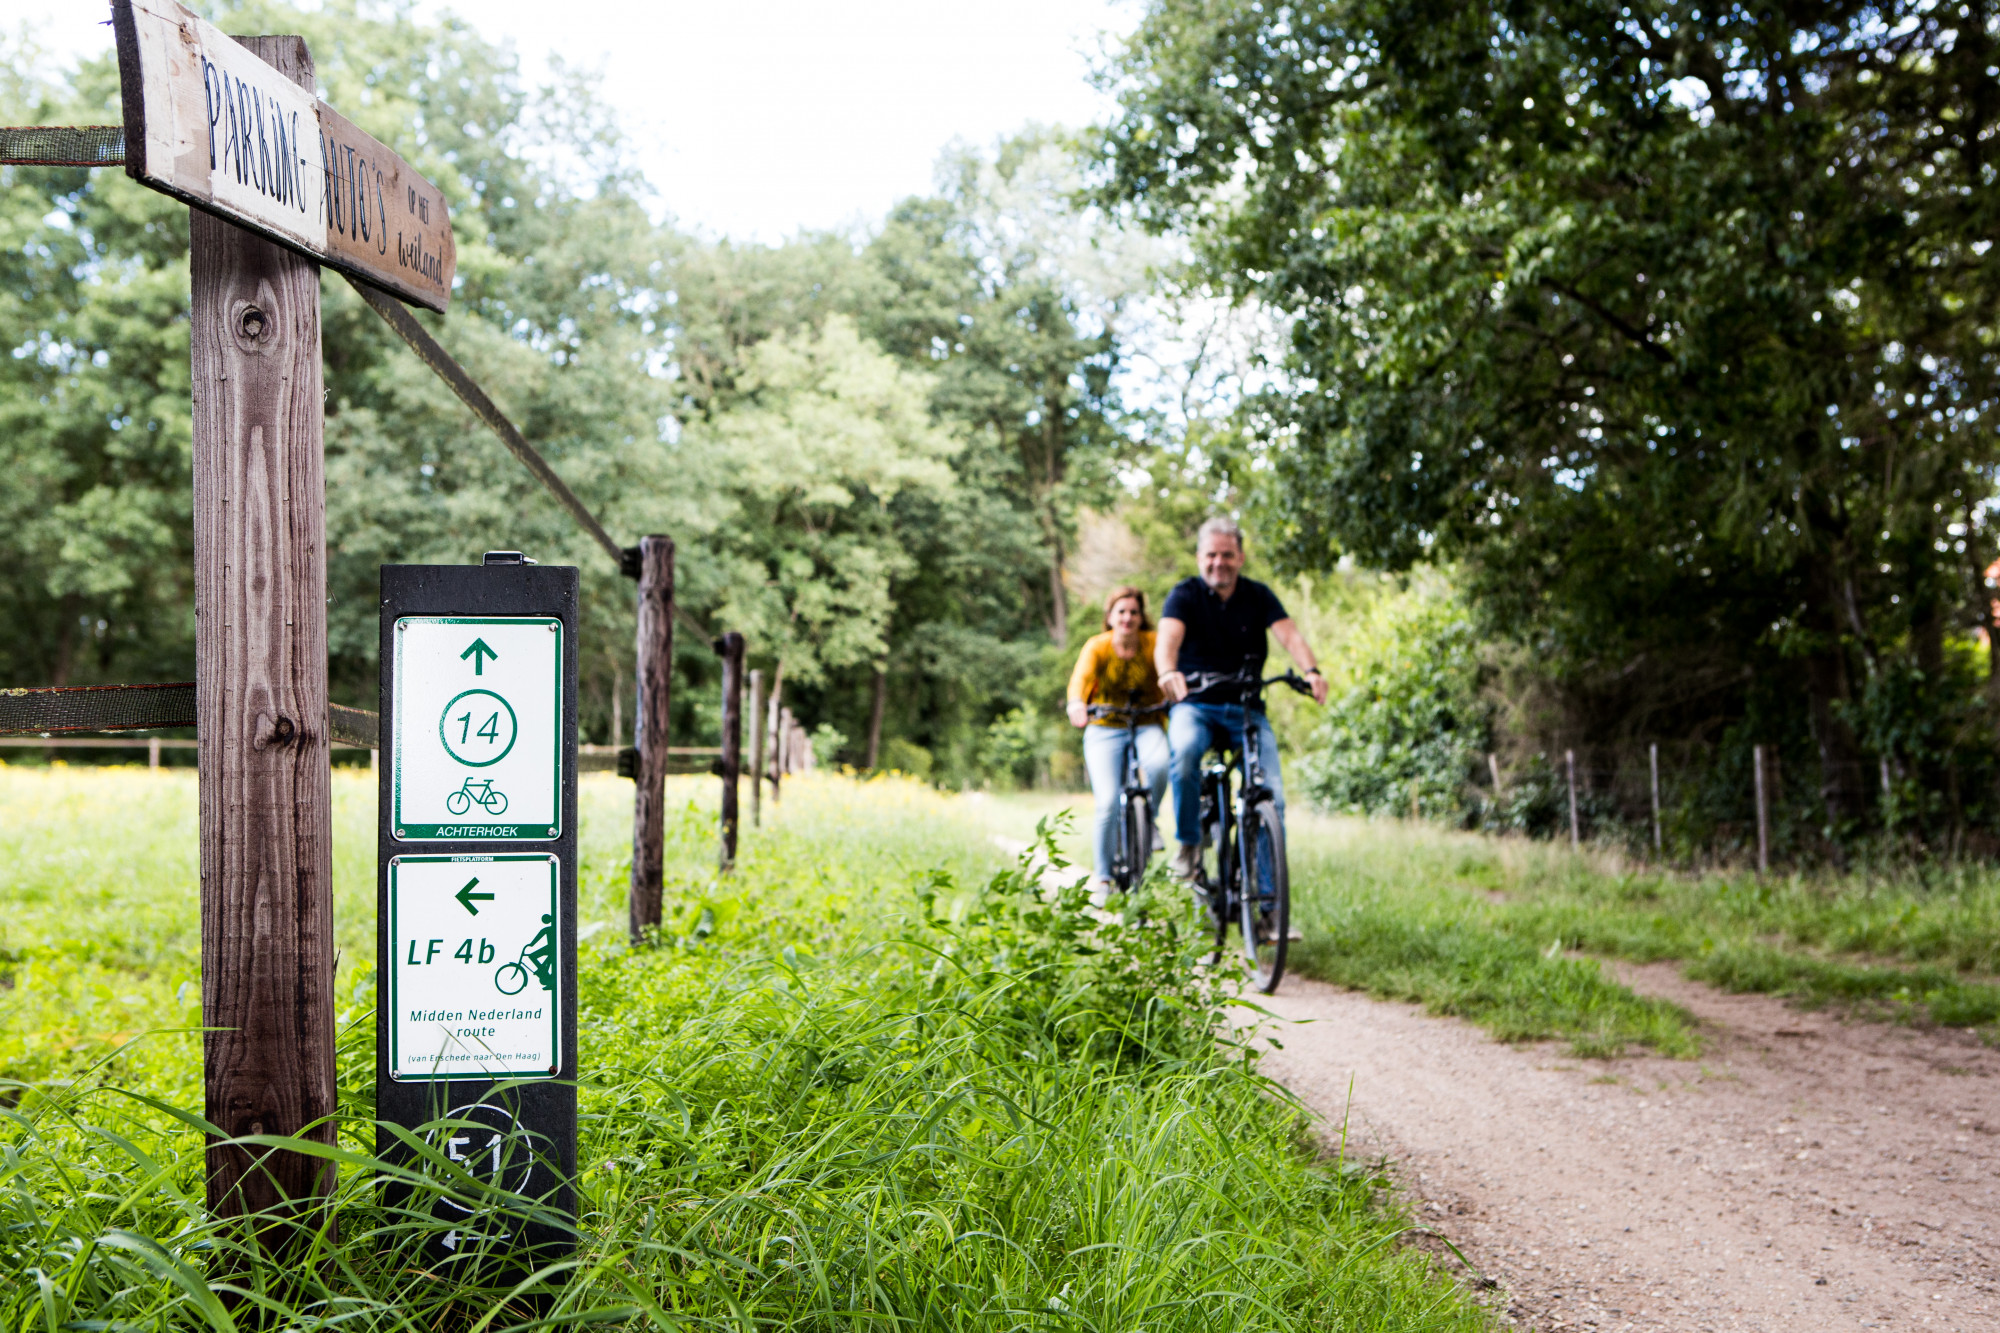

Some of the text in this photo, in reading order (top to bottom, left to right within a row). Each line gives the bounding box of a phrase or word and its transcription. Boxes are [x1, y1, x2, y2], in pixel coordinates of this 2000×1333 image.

[319, 127, 387, 256] AUTO'S
[418, 193, 430, 226] HET
[456, 711, 499, 745] 14
[436, 826, 519, 837] ACHTERHOEK
[407, 937, 495, 966] LF 4b
[409, 1007, 543, 1022] Midden Nederland
[456, 1026, 496, 1038] route
[407, 1052, 541, 1064] (van Enschede naar Den Haag)
